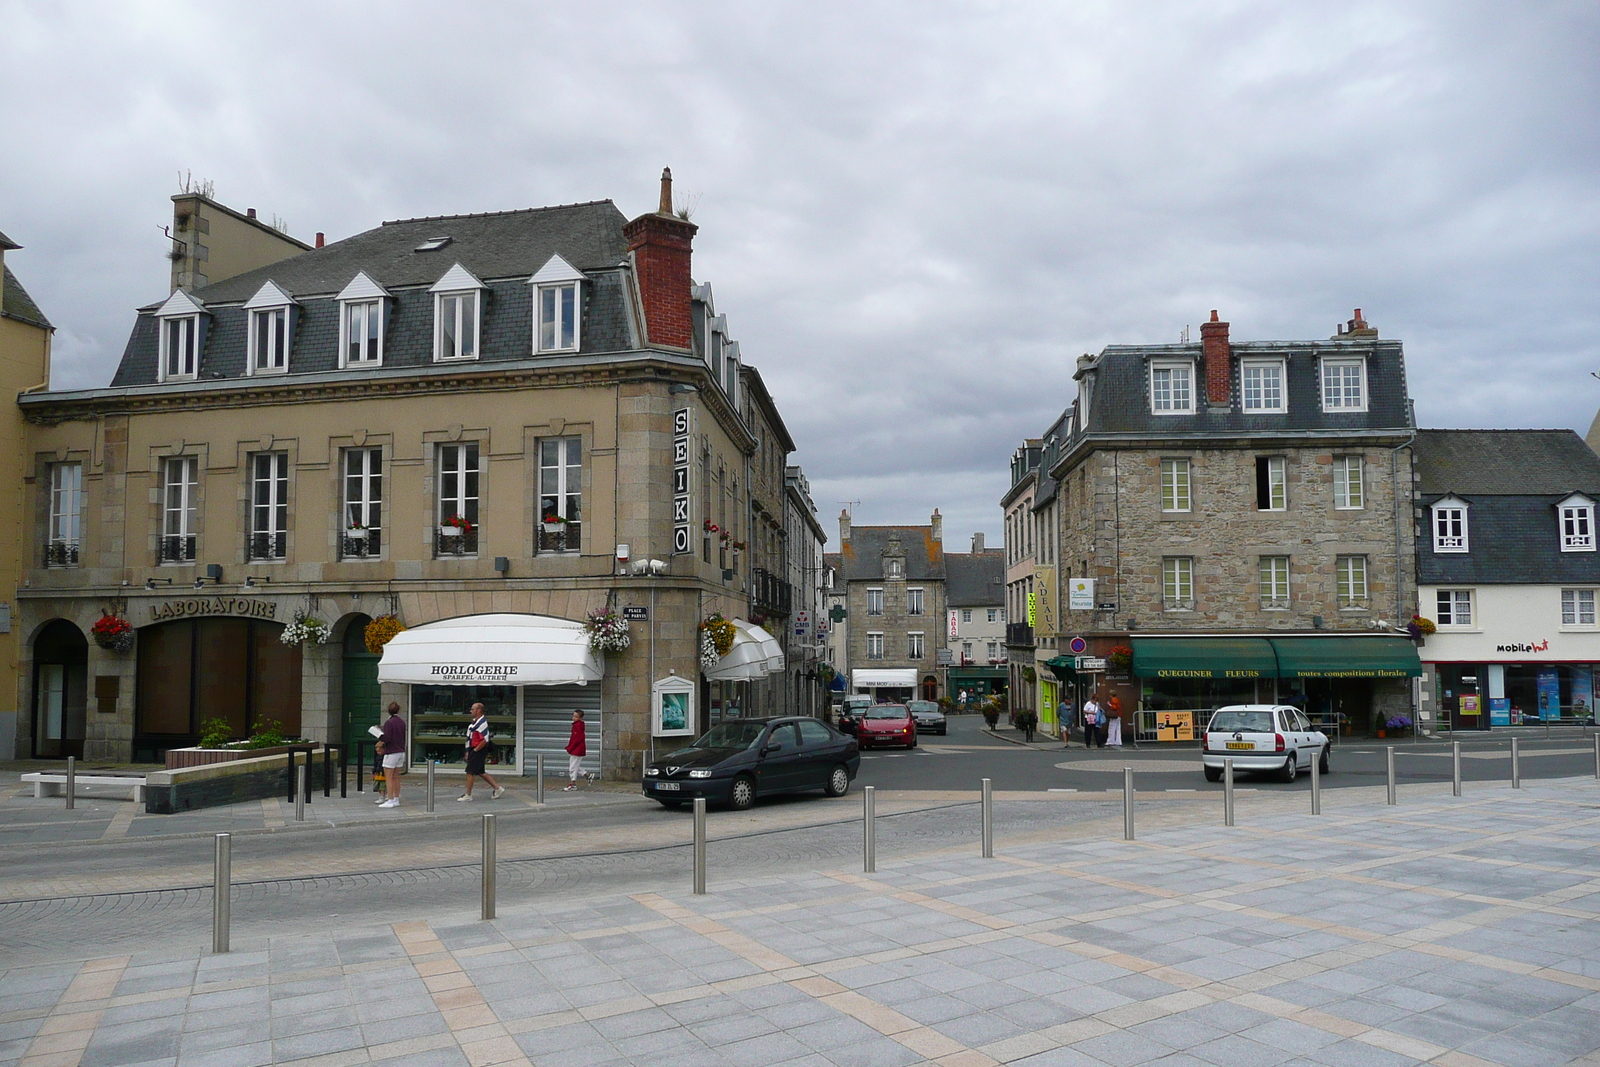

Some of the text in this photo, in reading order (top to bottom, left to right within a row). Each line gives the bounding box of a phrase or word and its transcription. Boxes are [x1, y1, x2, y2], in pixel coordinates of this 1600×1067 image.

[675, 412, 688, 551] SEIKO
[150, 596, 277, 620] LABORATOIRE
[1035, 571, 1055, 631] CADEAUX
[431, 665, 518, 675] HORLOGERIE
[1157, 669, 1213, 678] QUEGUINER
[1324, 669, 1375, 678] compositions
[1378, 669, 1407, 677] florales
